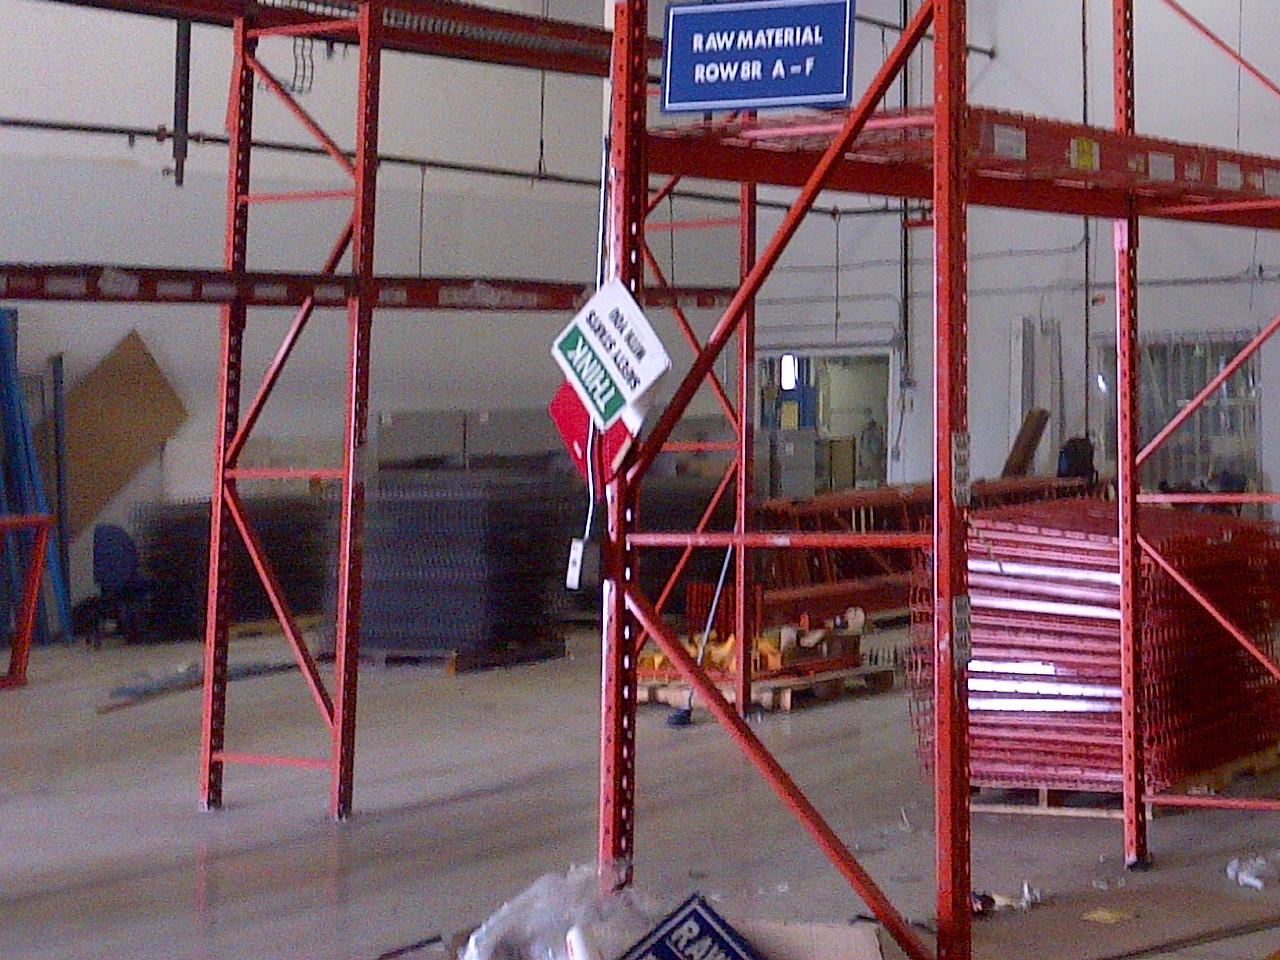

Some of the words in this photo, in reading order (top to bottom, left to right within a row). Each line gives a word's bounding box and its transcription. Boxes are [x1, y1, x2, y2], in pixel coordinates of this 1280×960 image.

[692, 30, 735, 53] RAW
[736, 24, 823, 51] MATERIAL
[694, 60, 739, 84] ROW
[567, 336, 616, 413] THINK
